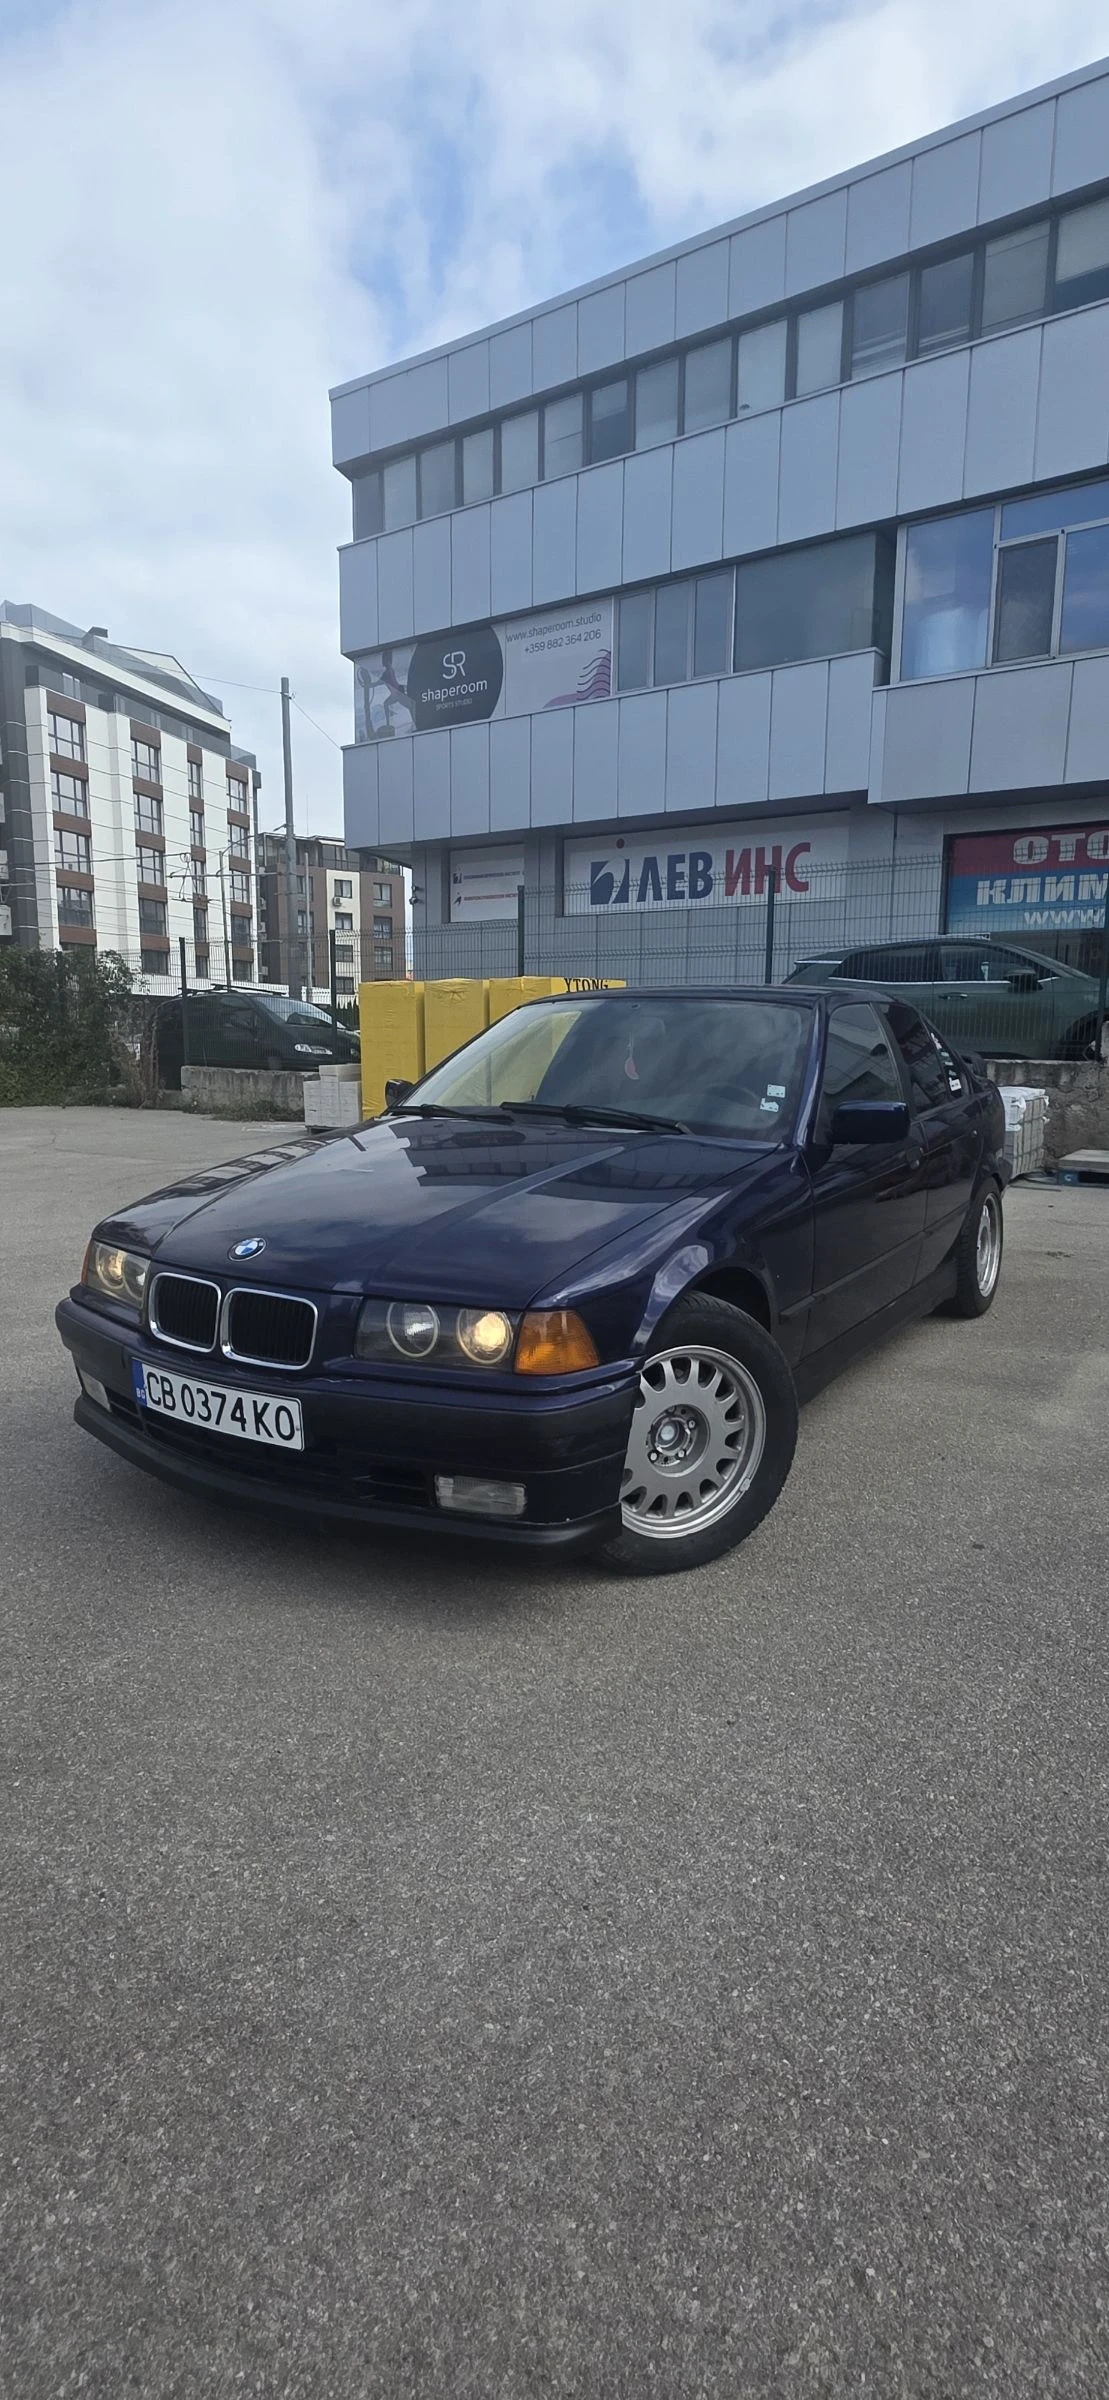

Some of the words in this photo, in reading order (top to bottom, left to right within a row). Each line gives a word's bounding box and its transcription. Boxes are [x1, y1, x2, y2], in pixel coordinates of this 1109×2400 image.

[505, 612, 602, 642] www.shaperoom.studio
[525, 641, 545, 653] +359
[547, 637, 563, 650] 882
[564, 633, 581, 646] 364
[583, 629, 602, 642] 206
[443, 651, 466, 679] SR
[421, 680, 488, 702] shaperoom
[636, 851, 713, 902] ЛЕВ
[724, 842, 811, 896] ИНС
[564, 977, 609, 993] YTONG
